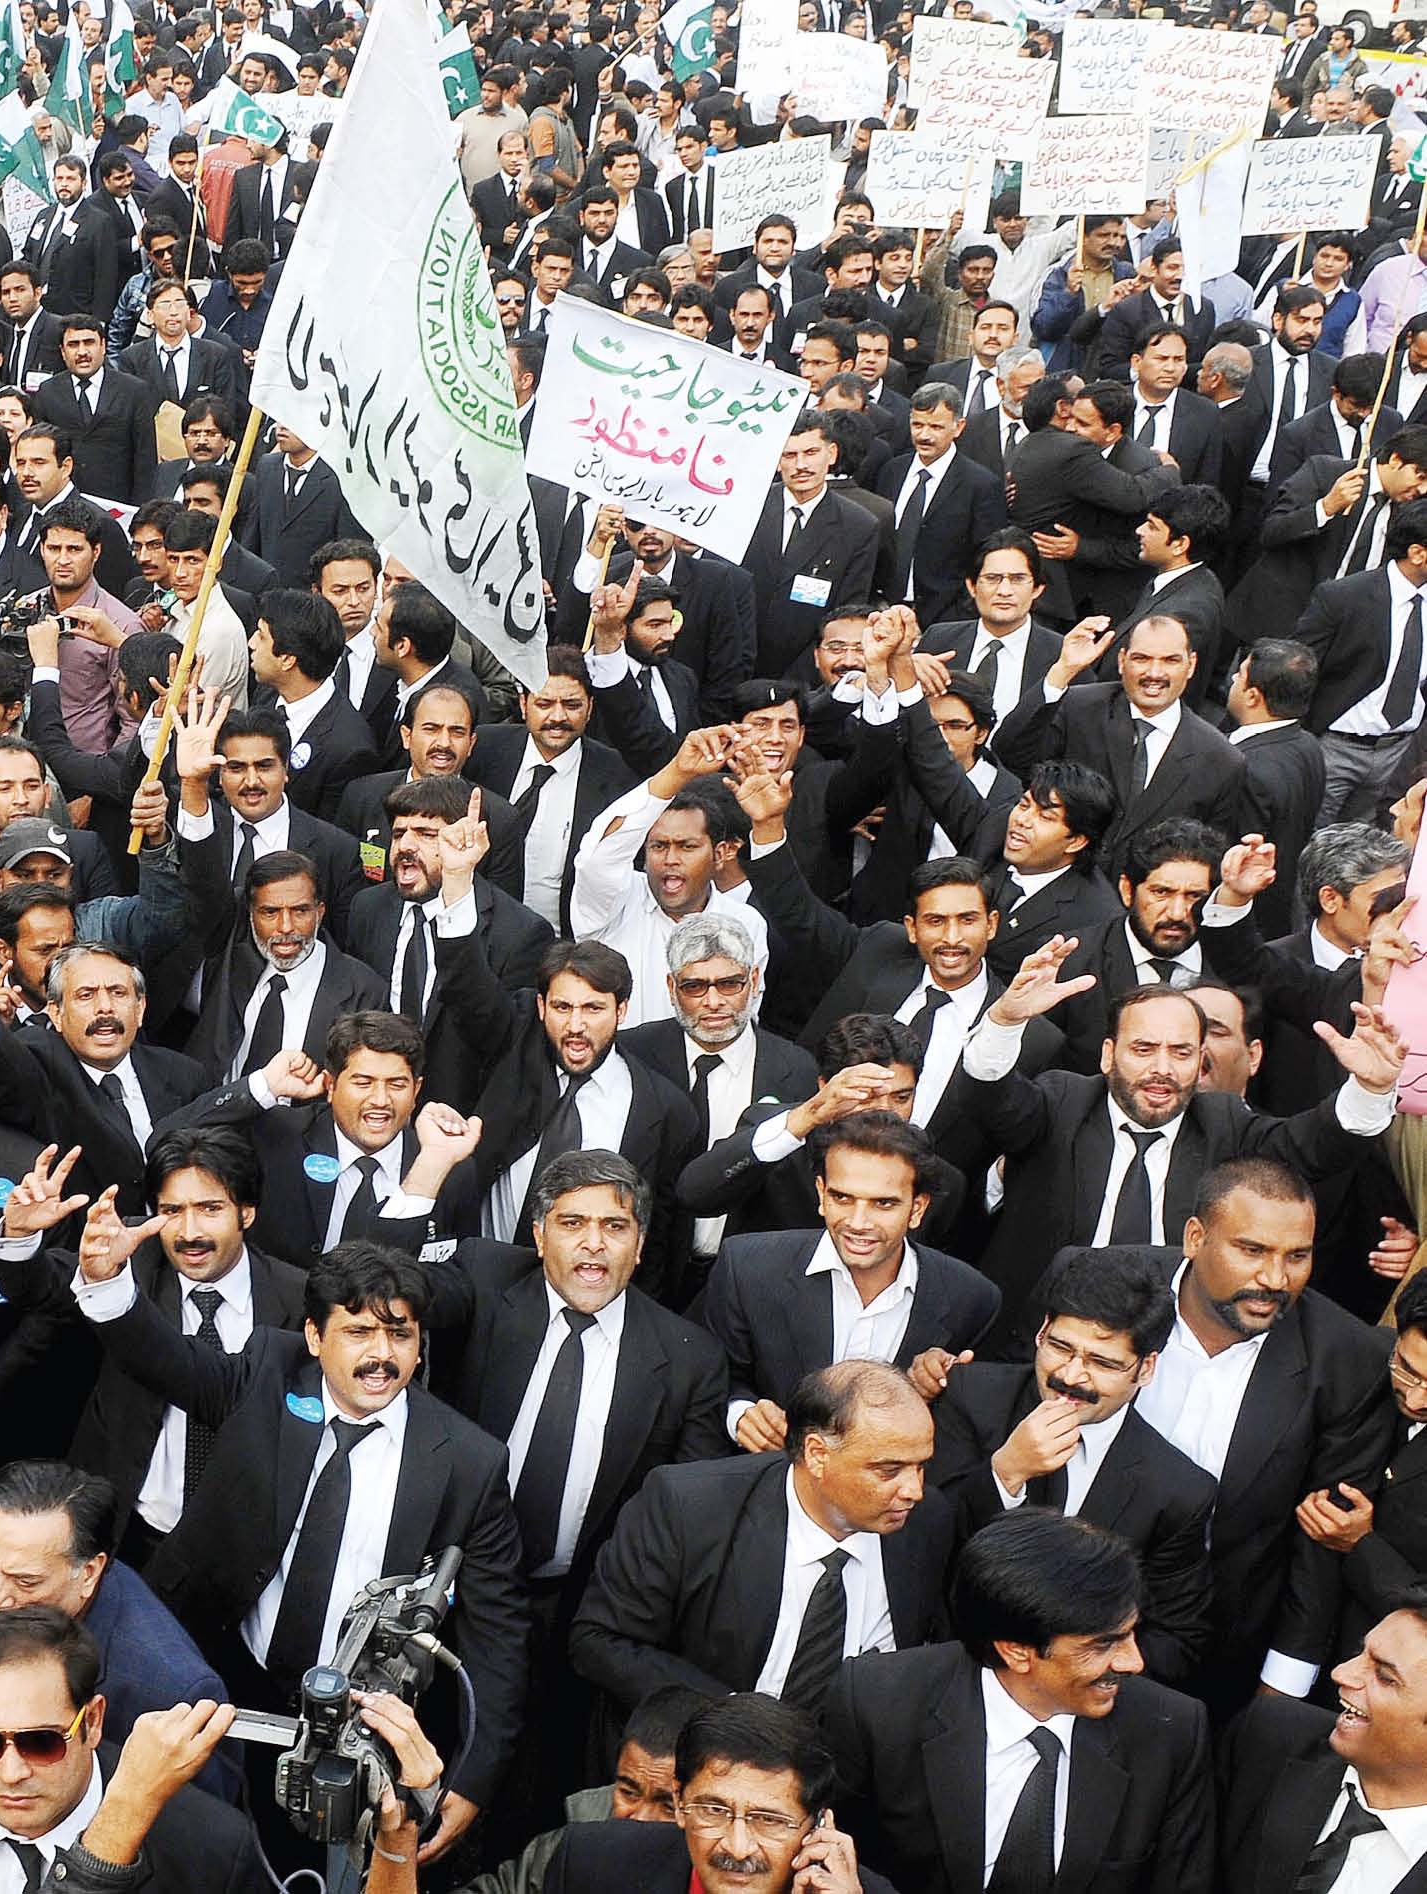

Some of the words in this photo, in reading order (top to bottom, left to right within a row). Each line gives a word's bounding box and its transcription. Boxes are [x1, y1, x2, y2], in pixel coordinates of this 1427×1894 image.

[572, 330, 725, 425] جارحیت
[708, 377, 800, 436] نیٹو
[642, 485, 664, 511] بار
[659, 504, 717, 527] لاہور
